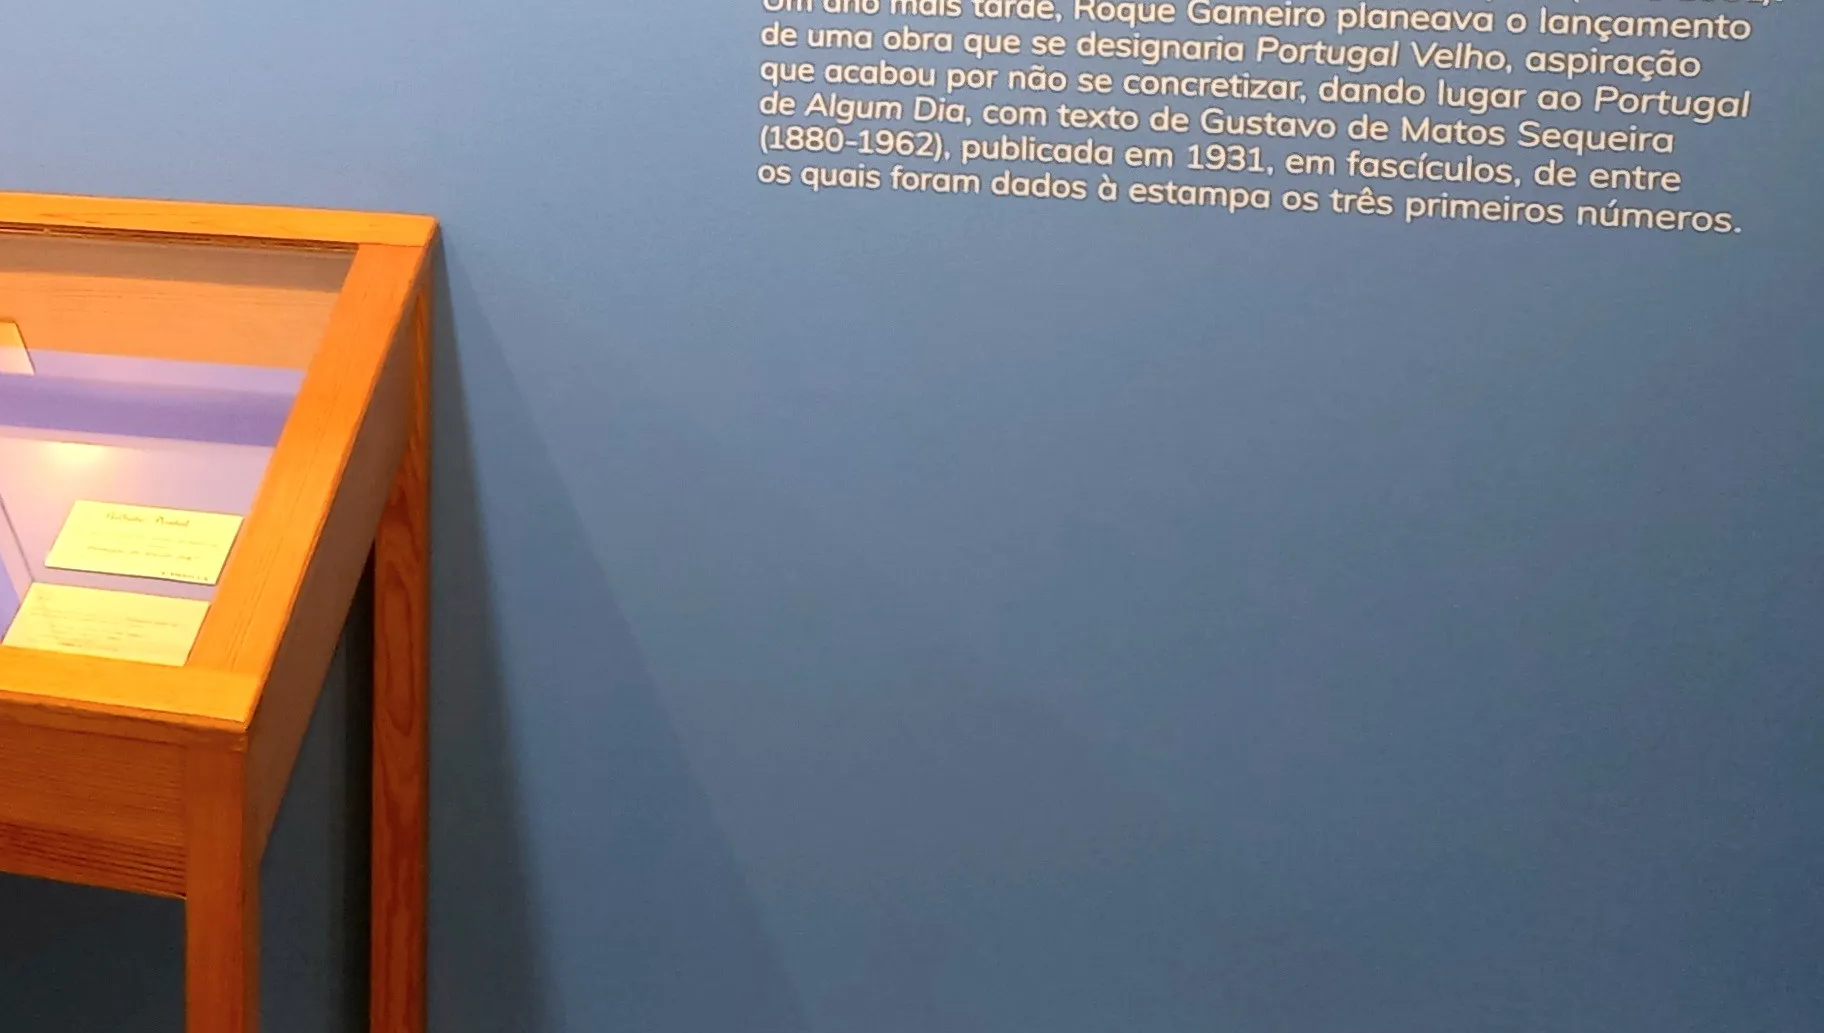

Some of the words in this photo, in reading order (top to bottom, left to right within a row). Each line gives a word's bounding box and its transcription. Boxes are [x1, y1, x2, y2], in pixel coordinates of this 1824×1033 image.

[761, 21, 798, 46] de
[807, 29, 872, 49] uma
[883, 25, 952, 52] obra
[963, 33, 1021, 59] que
[1031, 35, 1066, 55] se
[1076, 30, 1244, 65] designaria
[1256, 36, 1399, 73] Portugal
[1410, 41, 1512, 74] Velho,
[1525, 47, 1701, 82] aspiração
[1337, 2, 1494, 35] planeava
[1506, 13, 1527, 33] o
[1540, 6, 1752, 43] lançamento
[759, 90, 796, 116] de
[804, 92, 902, 125] Algum
[913, 96, 972, 126] Dia,
[982, 105, 1047, 126] com
[1056, 104, 1139, 130] texto
[1149, 105, 1189, 132] de
[1200, 107, 1336, 139] Gustavo
[1347, 113, 1389, 141] de
[1401, 116, 1505, 146] Matos
[1517, 120, 1674, 156] Sequeira
[760, 61, 815, 87] que
[824, 59, 936, 86] acabou
[947, 68, 999, 94] por
[1008, 64, 1067, 92] não
[1077, 73, 1113, 93] se
[1123, 72, 1307, 104] concretizar,
[1318, 75, 1426, 105] dando
[1438, 78, 1527, 115] lugar
[1537, 90, 1582, 111] ao
[1594, 85, 1751, 124] Portugal
[760, 125, 950, 162] (1880-1962),
[961, 134, 1113, 165] publicada
[1124, 146, 1173, 168] em
[1187, 144, 1274, 176] 1931,
[1285, 154, 1335, 176] em
[1345, 150, 1521, 188] fascículos,
[1534, 158, 1577, 187] de
[1589, 165, 1682, 192] entre
[757, 164, 792, 184] os
[800, 163, 881, 192] quais
[890, 164, 980, 194] foram
[991, 169, 1087, 200] dados
[1097, 173, 1117, 201] à
[1128, 180, 1271, 214] estampa
[1282, 190, 1319, 211] os
[1329, 186, 1393, 215] três
[1405, 192, 1564, 224] primeiros
[1577, 198, 1742, 233] números.
